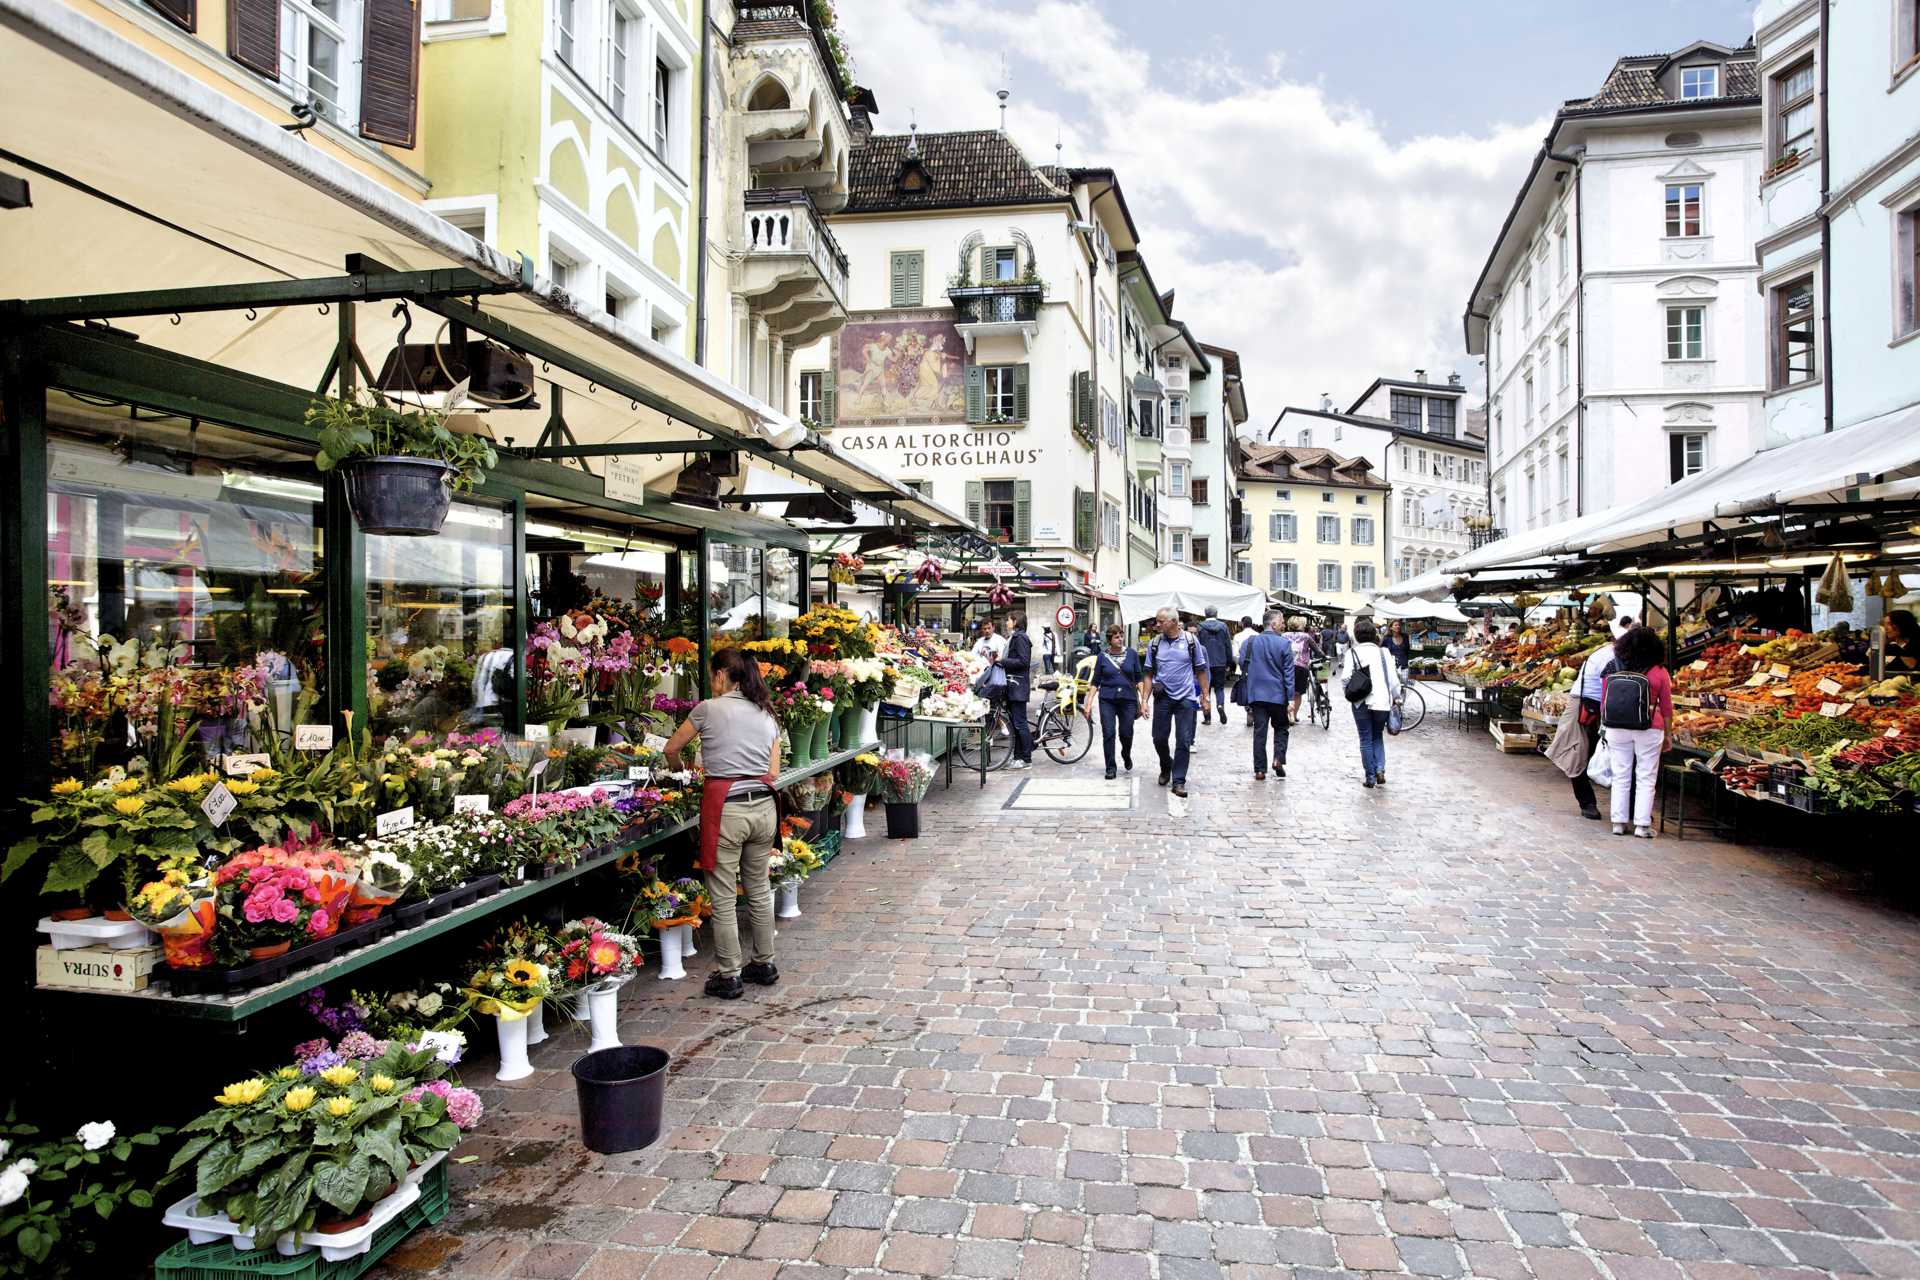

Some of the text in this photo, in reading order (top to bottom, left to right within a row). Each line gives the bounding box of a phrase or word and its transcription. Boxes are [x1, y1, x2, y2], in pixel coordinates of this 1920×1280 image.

[841, 435, 889, 450] CASA
[894, 434, 917, 449] AL
[64, 961, 109, 977] SUPRA
